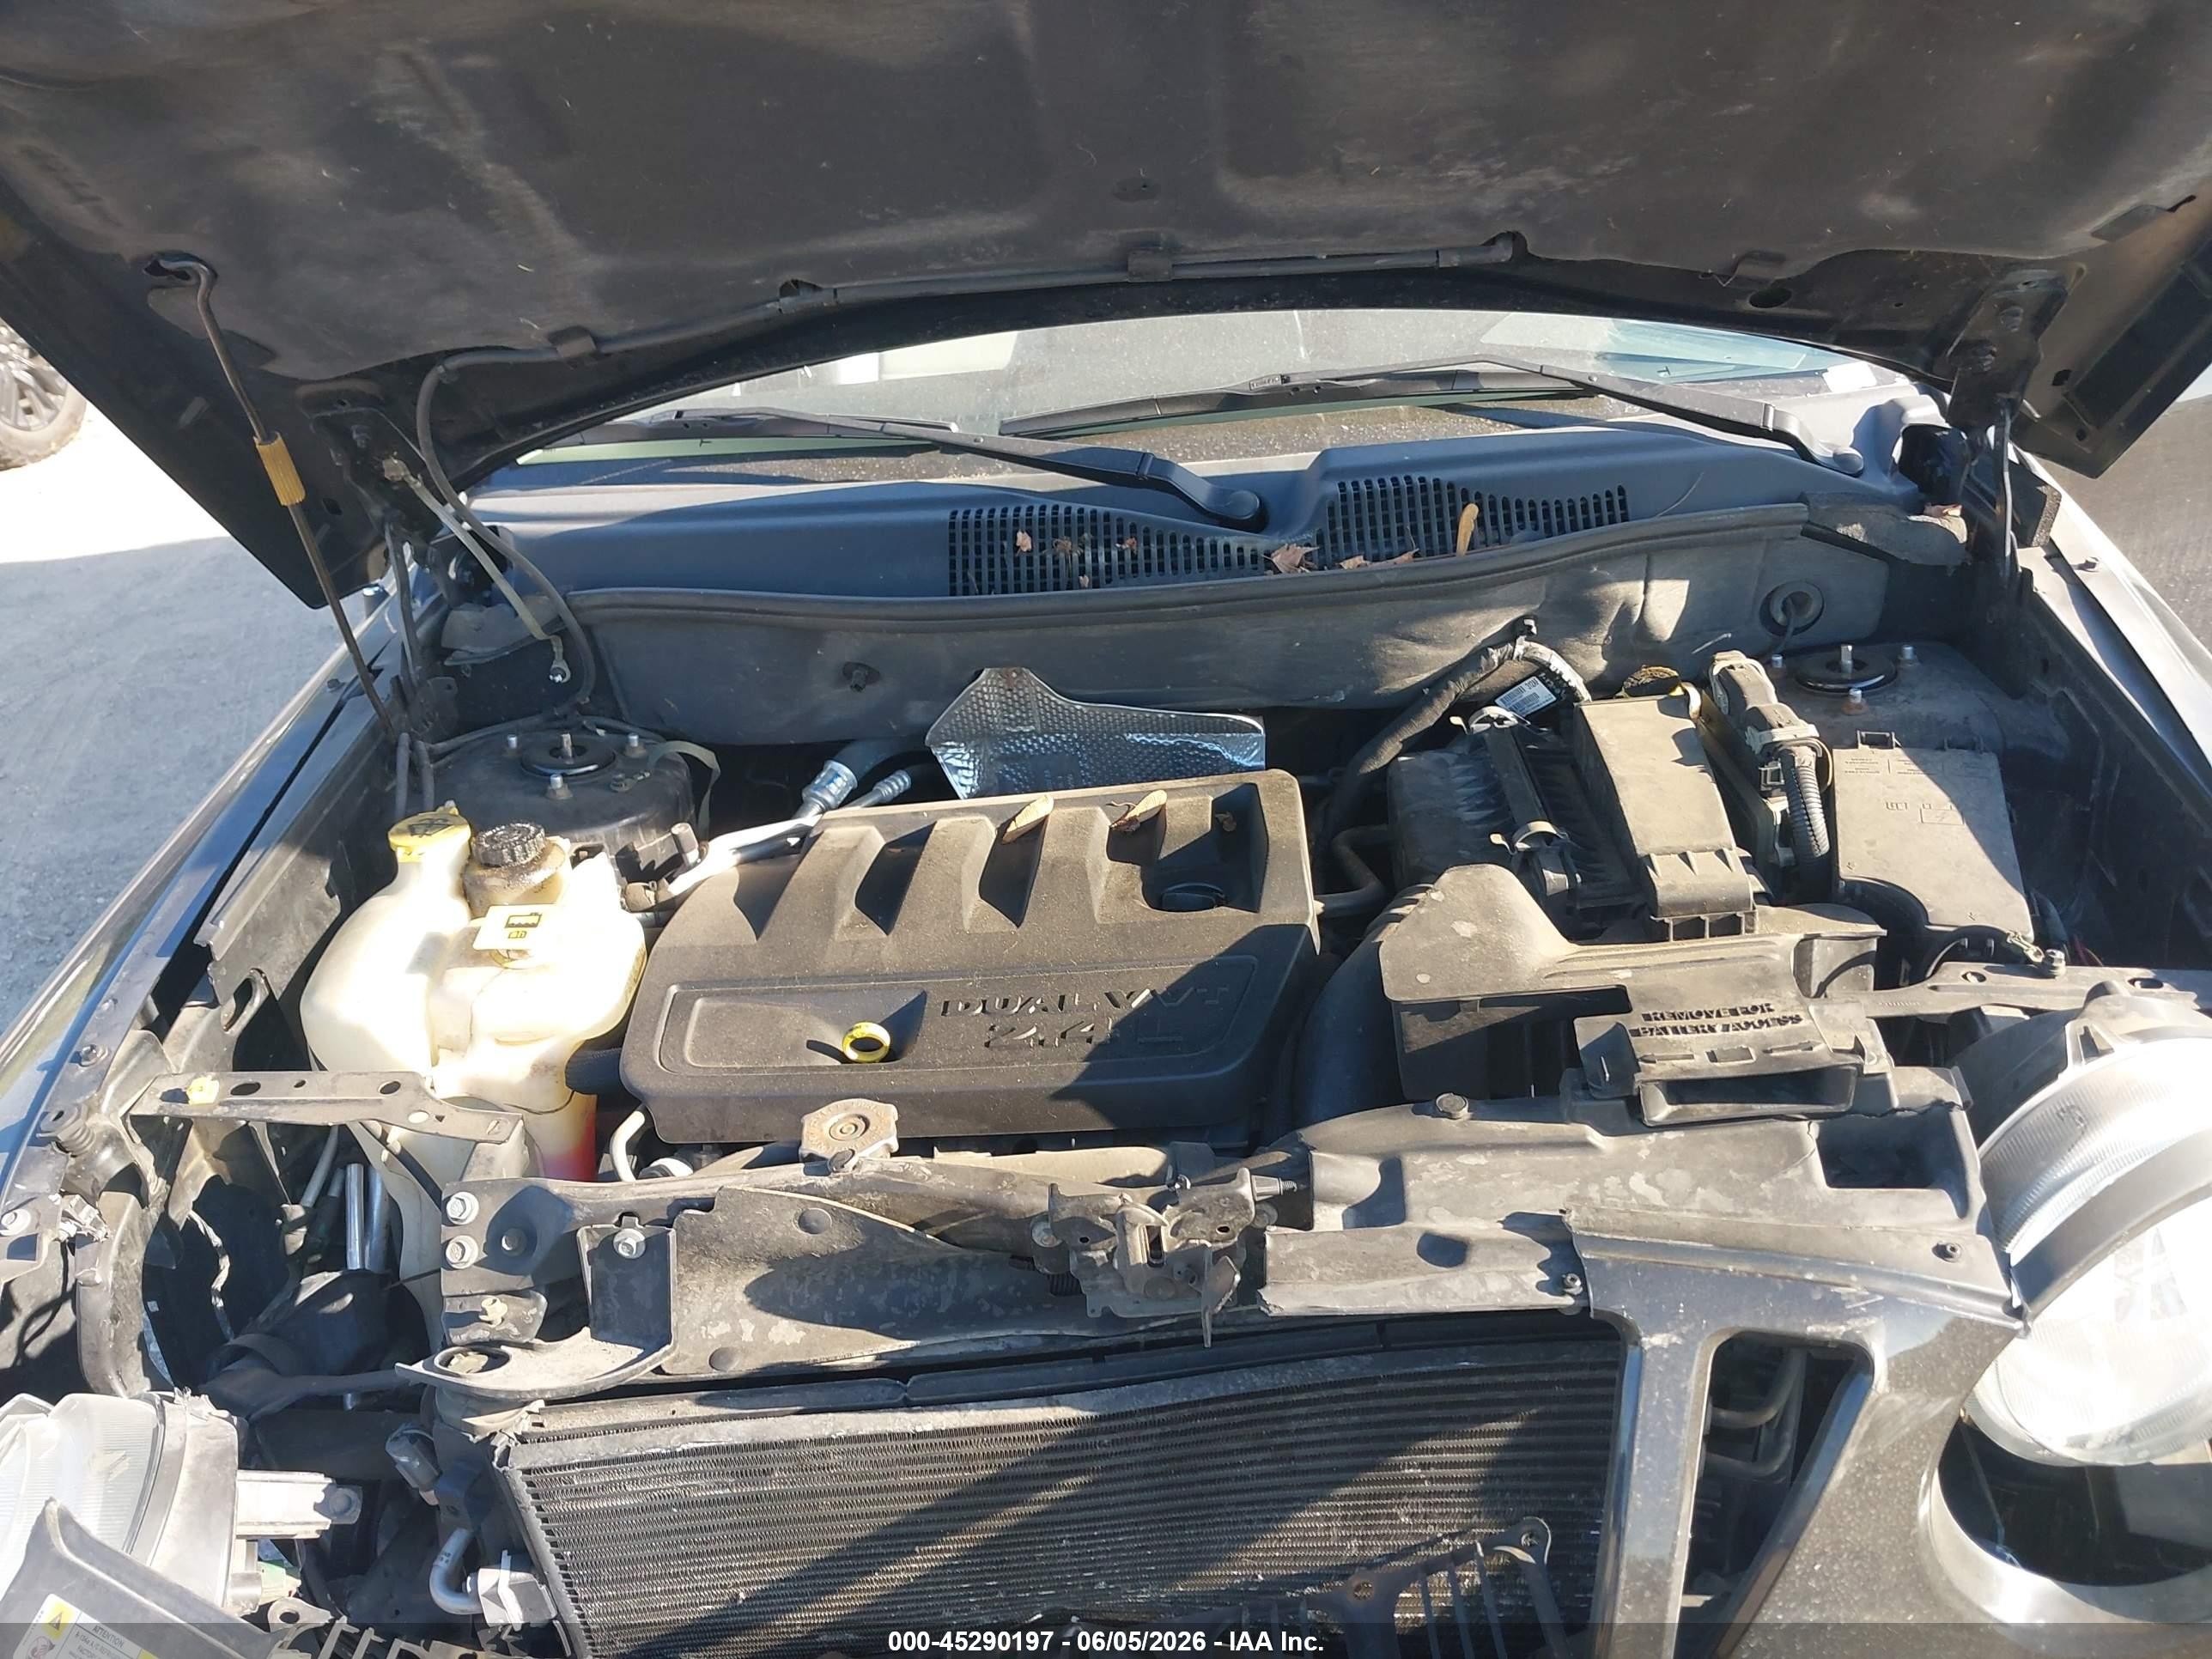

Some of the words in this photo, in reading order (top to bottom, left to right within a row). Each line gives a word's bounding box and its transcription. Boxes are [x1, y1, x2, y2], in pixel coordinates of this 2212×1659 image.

[939, 992, 1098, 1017] DUAL
[1103, 985, 1231, 1012] VVT
[1649, 1007, 1730, 1022] REMOVE
[1739, 1002, 1776, 1017] FOR
[1637, 1022, 1720, 1037] BATTERY
[1729, 1013, 1804, 1033] ACCESS
[92, 1624, 125, 1649] ATTENTION
